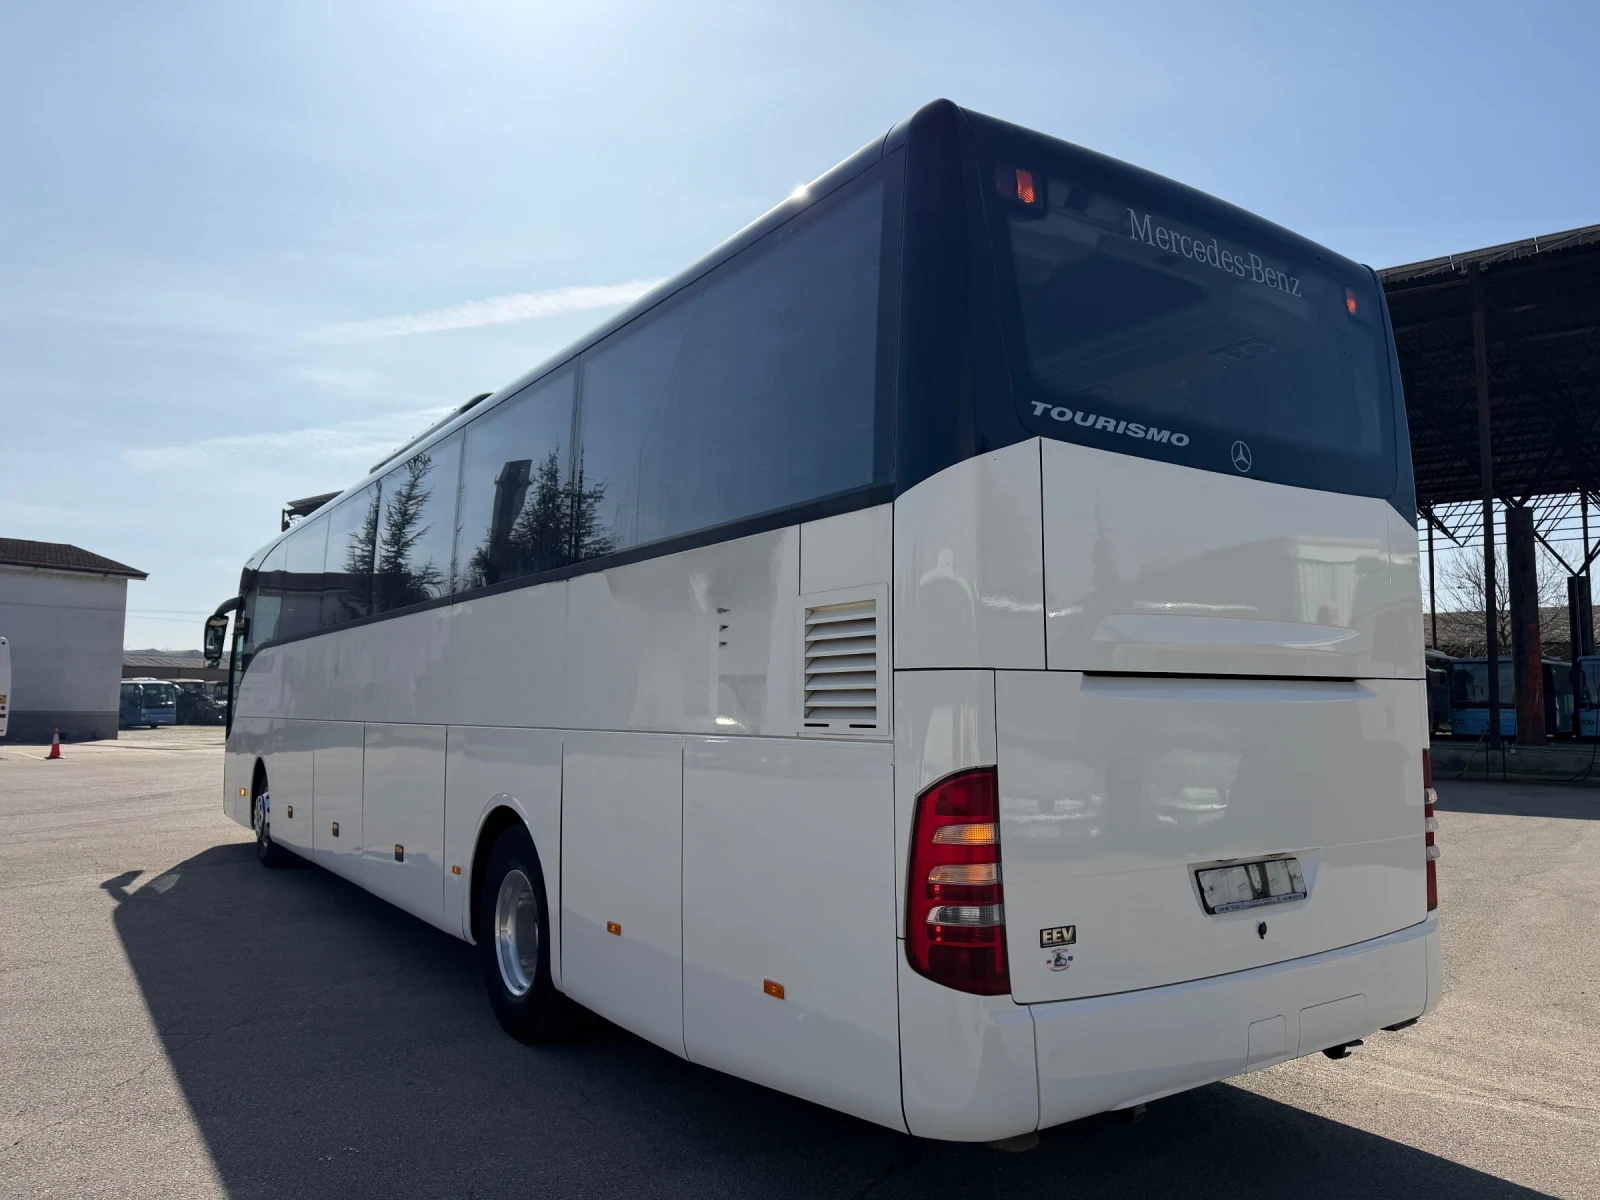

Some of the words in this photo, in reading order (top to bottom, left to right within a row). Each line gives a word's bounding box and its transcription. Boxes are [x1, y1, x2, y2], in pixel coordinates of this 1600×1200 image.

[1127, 207, 1302, 298] Mercedes-Benz
[1031, 400, 1190, 447] TOURISMO
[1042, 926, 1075, 944] EEV
